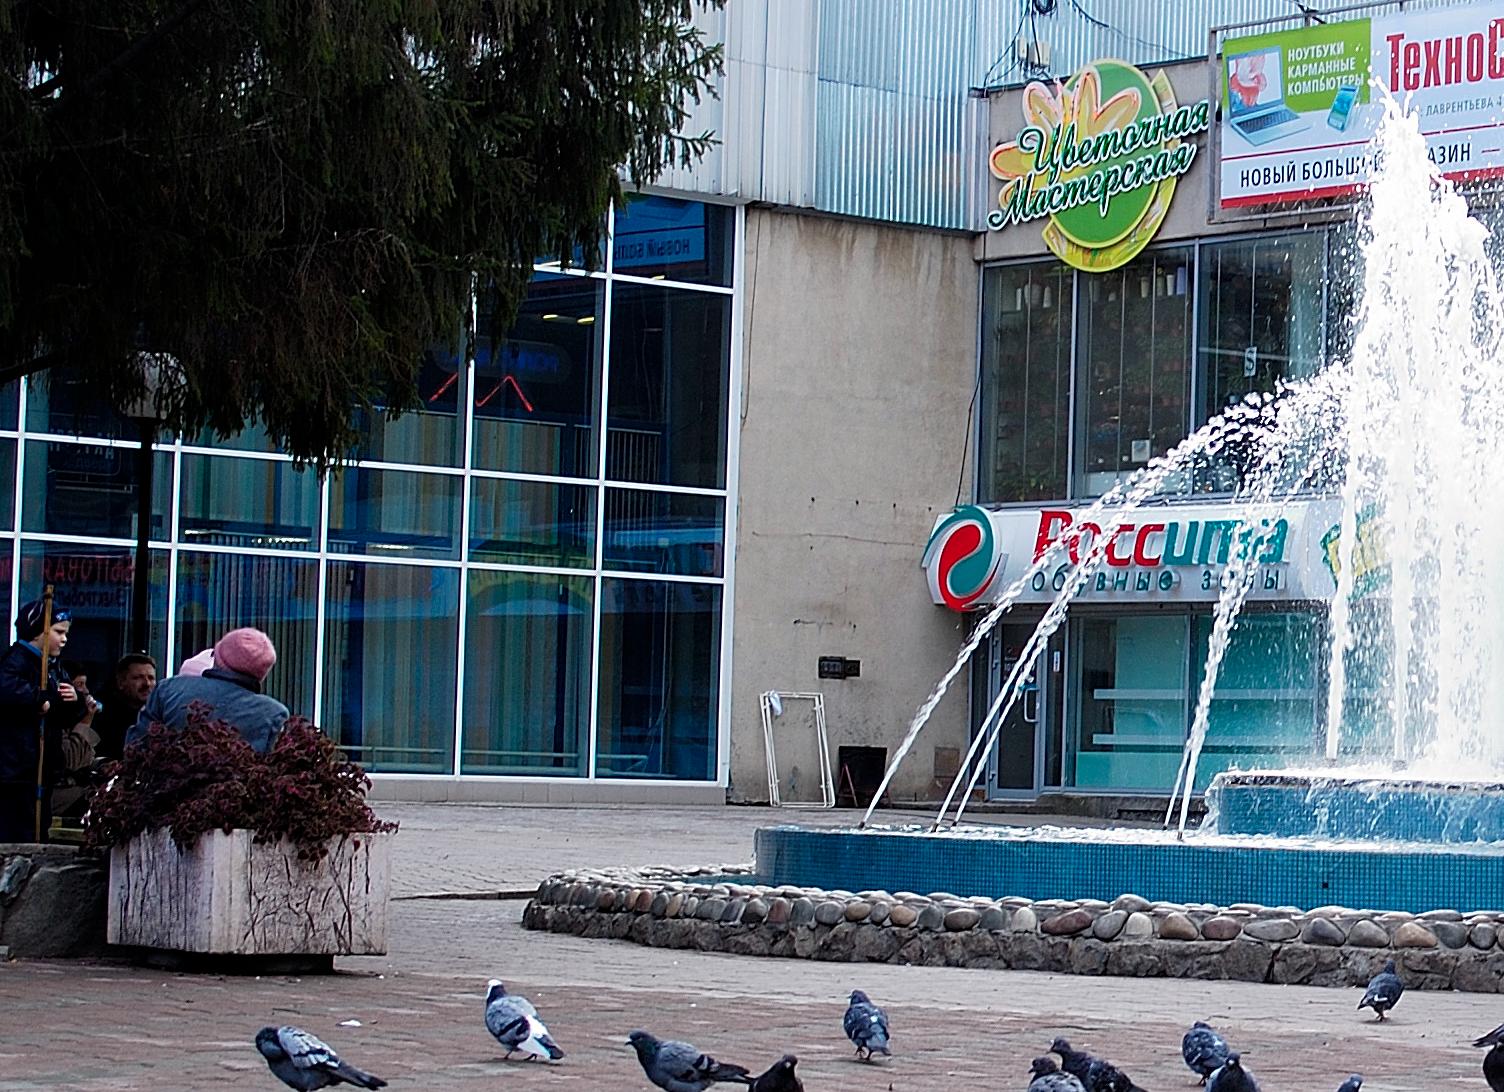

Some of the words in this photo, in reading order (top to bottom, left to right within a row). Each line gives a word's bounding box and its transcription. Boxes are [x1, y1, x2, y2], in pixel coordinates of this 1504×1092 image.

[1287, 41, 1345, 62] НОУТБУКИ
[1287, 57, 1356, 79] КАРМАННЫЕ
[1287, 73, 1364, 97] КОМПЬЮТЕРЫ
[1425, 98, 1494, 117] ЛАВРЕНТЬЕВА
[1016, 98, 1211, 187] Цветочная
[1240, 160, 1296, 188] НОВЫЙ
[987, 142, 1197, 231] Мастерская
